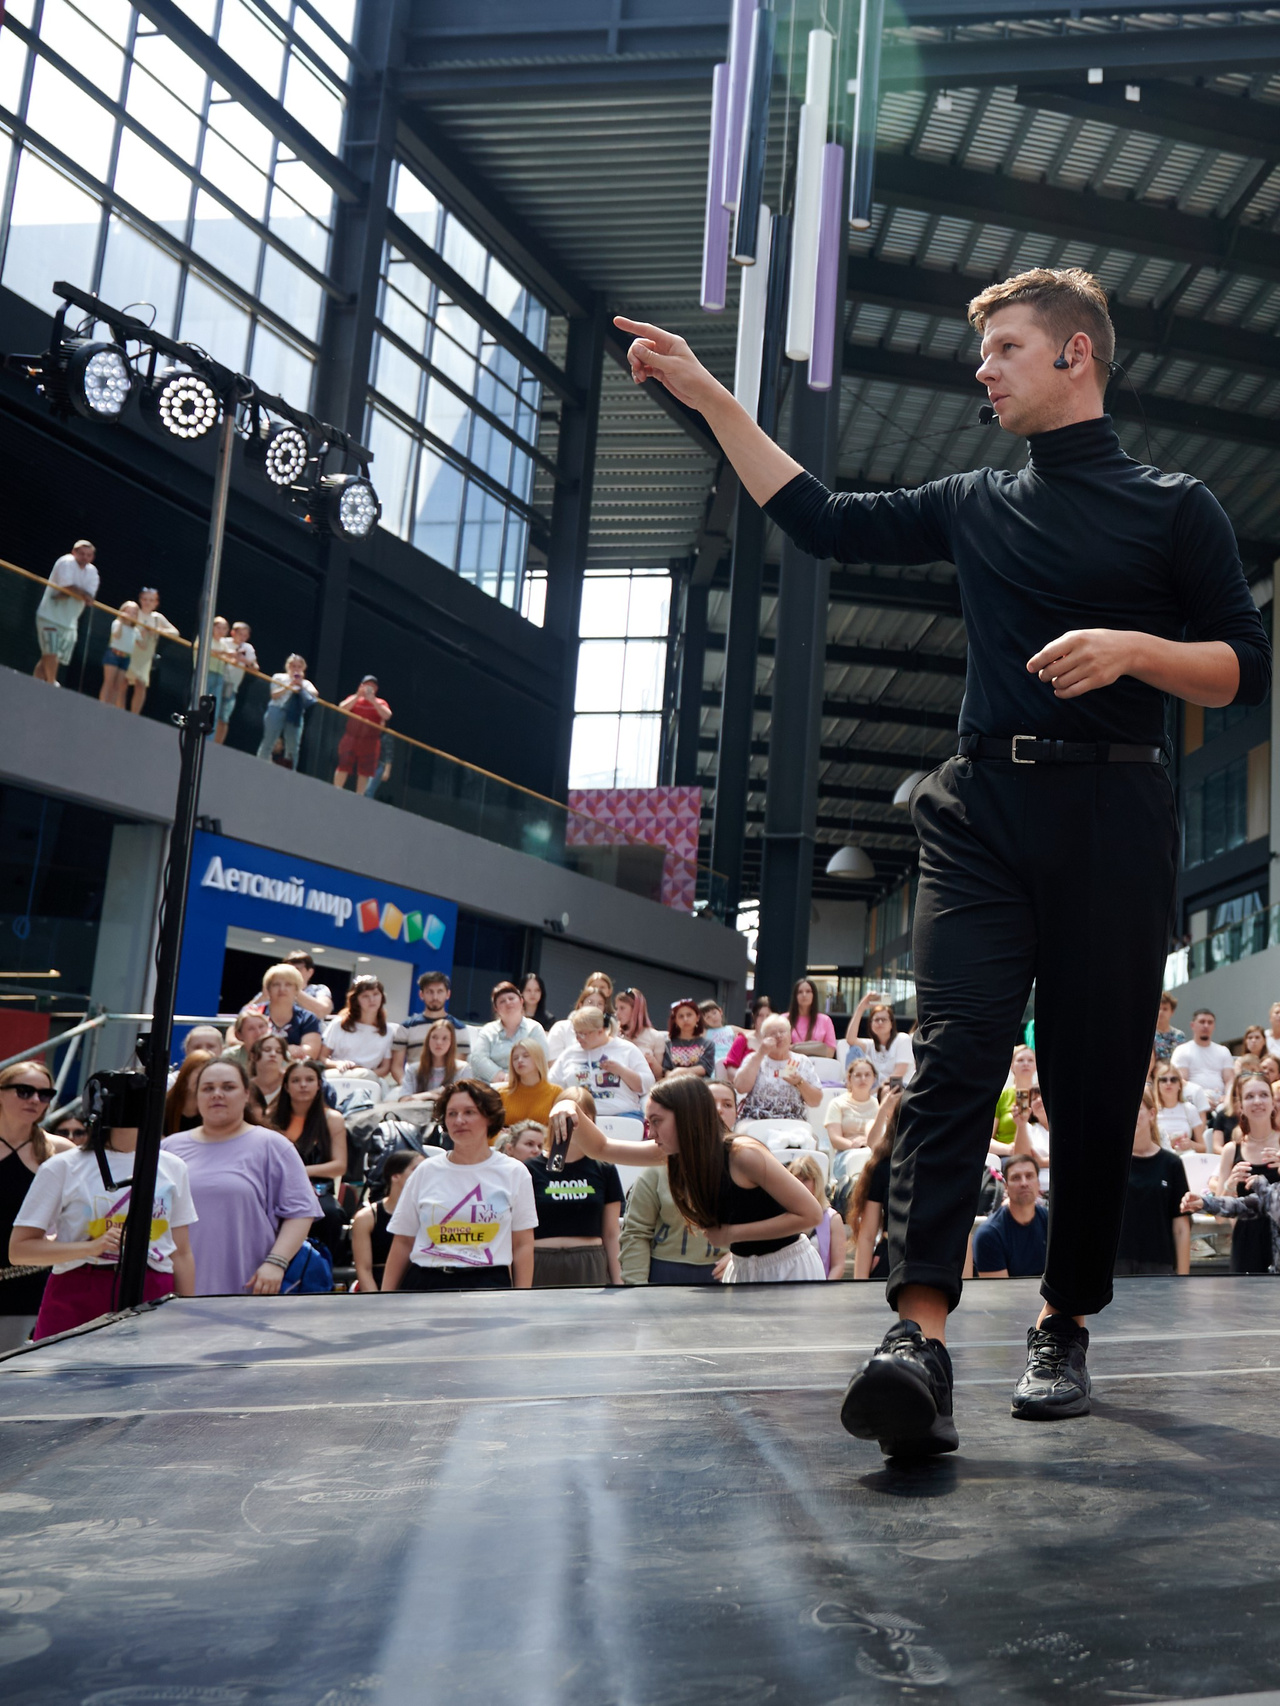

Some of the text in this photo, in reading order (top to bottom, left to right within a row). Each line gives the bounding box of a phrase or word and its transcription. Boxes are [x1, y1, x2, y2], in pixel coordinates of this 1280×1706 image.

[200, 855, 353, 928] Детский мир
[440, 1225, 472, 1234] Dance
[440, 1232, 484, 1243] BATTLE
